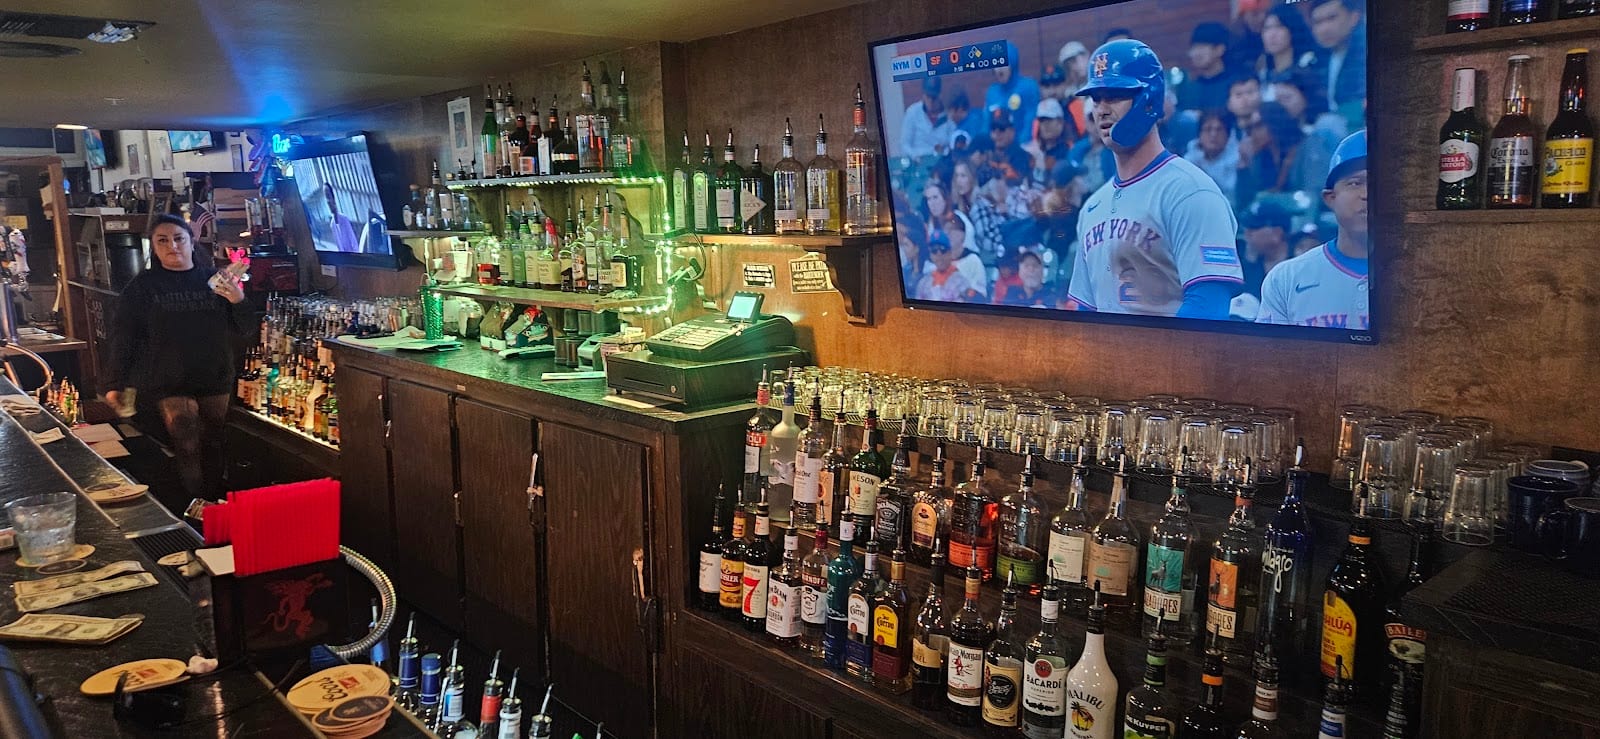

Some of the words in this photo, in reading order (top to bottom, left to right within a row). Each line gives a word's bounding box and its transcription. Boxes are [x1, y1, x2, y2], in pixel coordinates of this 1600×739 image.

[893, 62, 910, 71] NYM
[914, 57, 922, 69] 0
[930, 56, 941, 66] SF
[949, 51, 959, 64] 0
[1085, 221, 1107, 253] EW
[1109, 218, 1162, 254] YORK
[743, 576, 760, 614] 7
[1324, 615, 1352, 637] HLÚA
[1388, 624, 1425, 638] BAILE
[960, 649, 981, 662] Morgan
[1026, 673, 1062, 689] BACARDÍ
[1067, 688, 1106, 711] MALIBU
